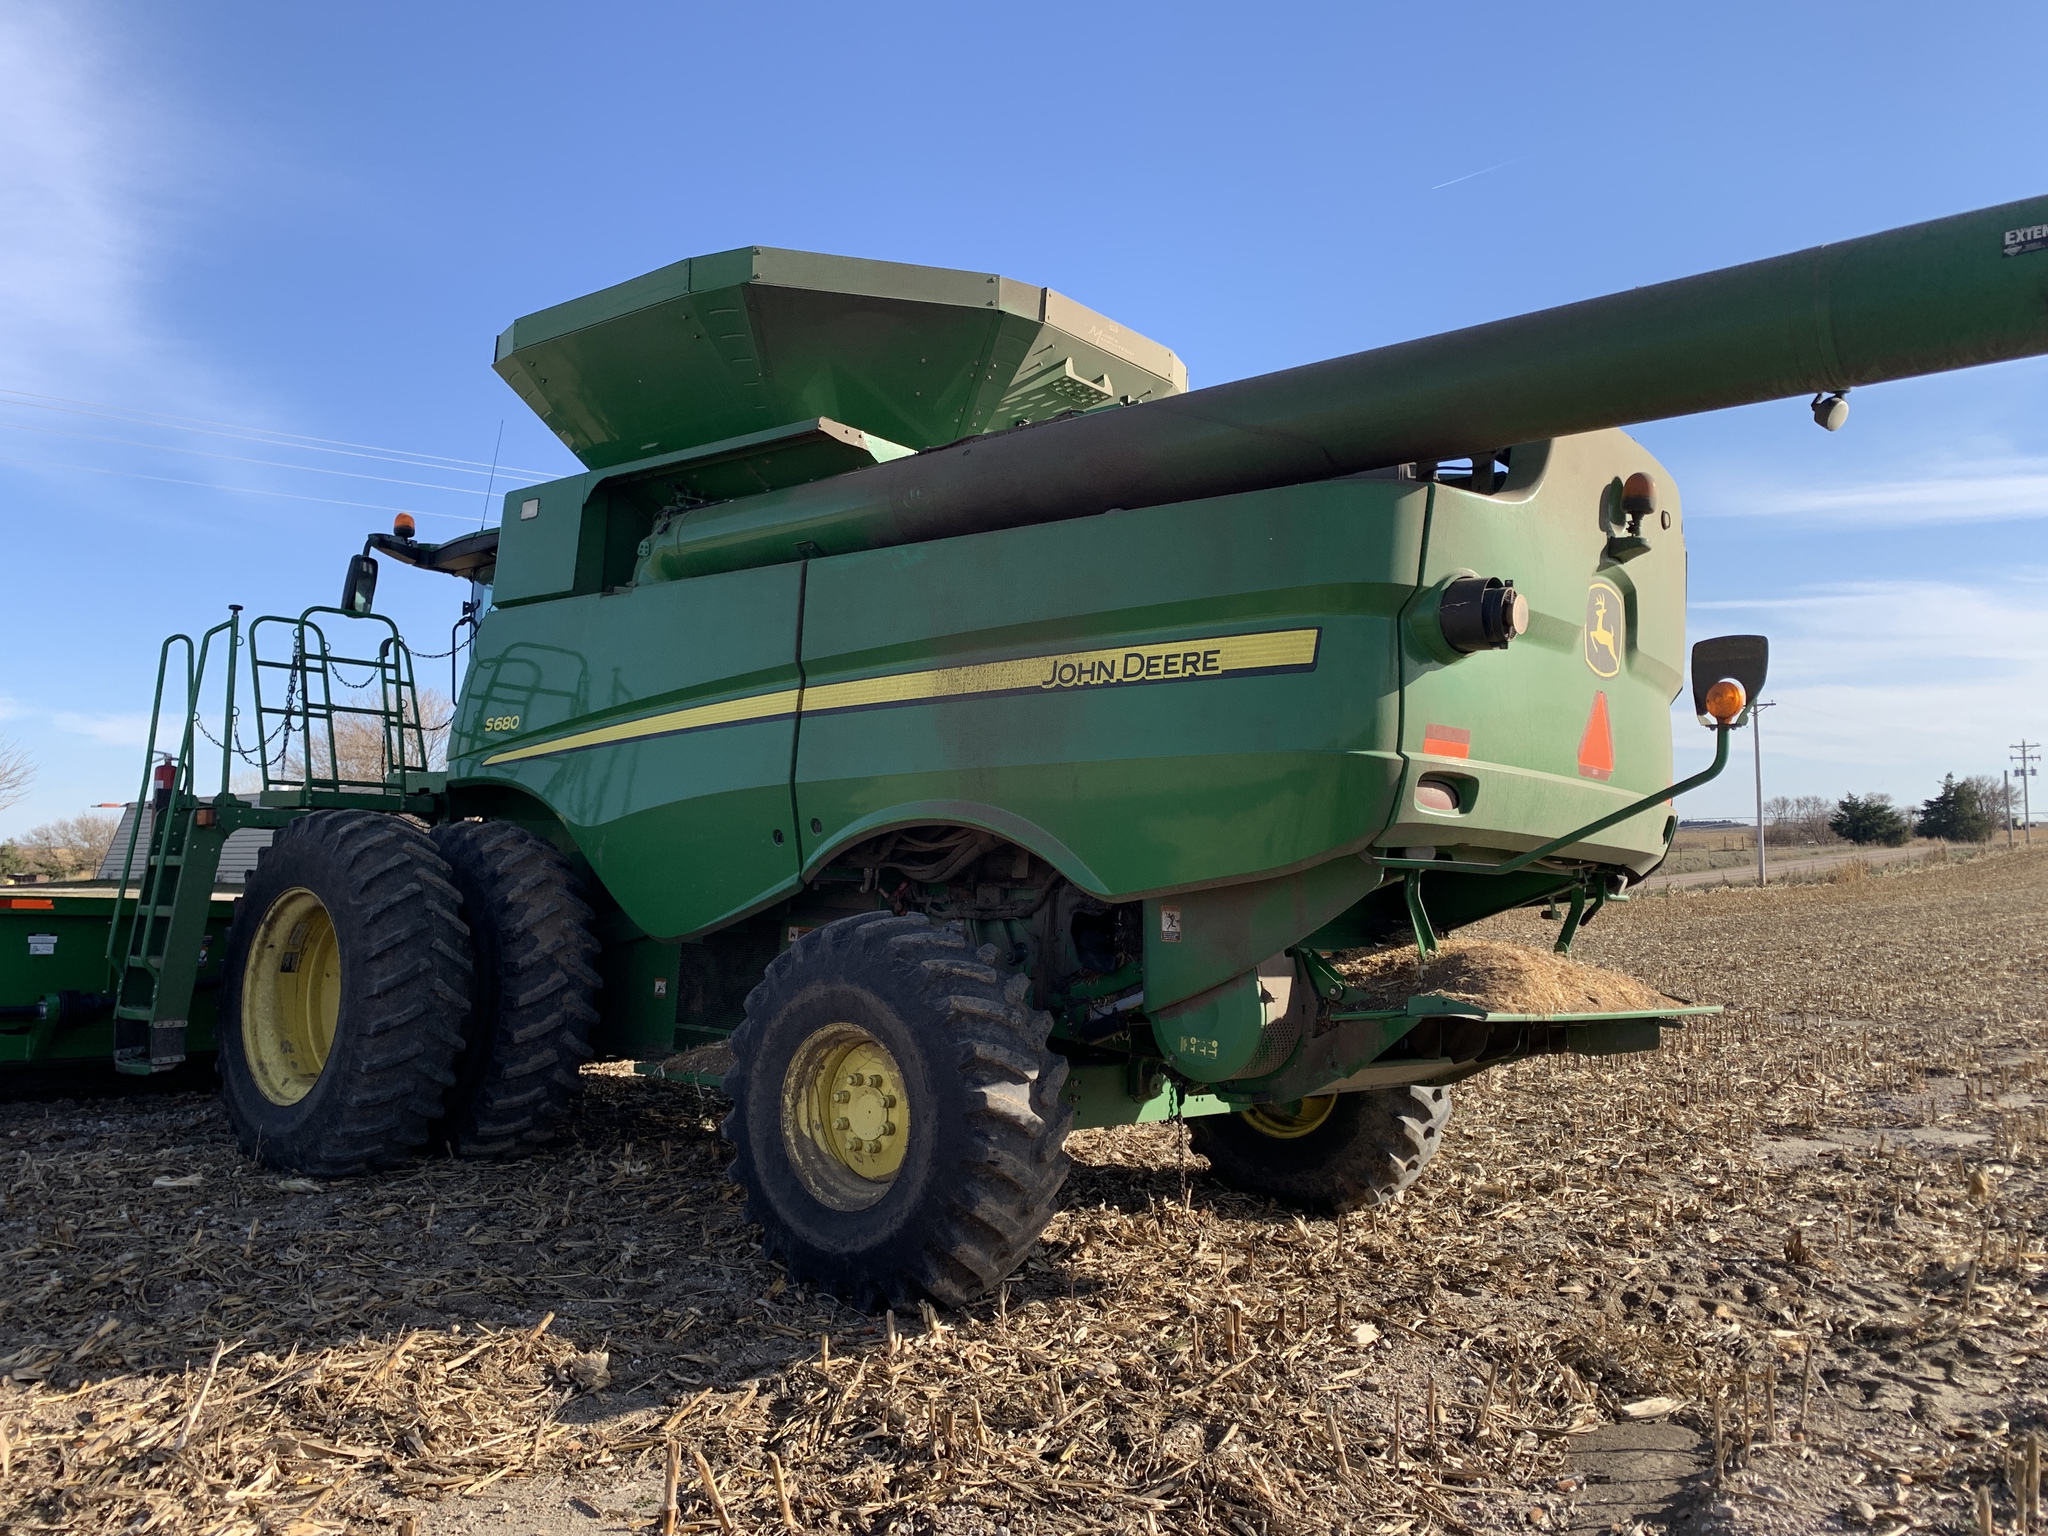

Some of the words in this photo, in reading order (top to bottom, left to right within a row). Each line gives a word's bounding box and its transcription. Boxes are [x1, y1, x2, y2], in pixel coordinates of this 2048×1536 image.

[1042, 659, 1116, 685] JOHN
[1122, 650, 1221, 679] DEERE
[484, 715, 520, 732] S680
